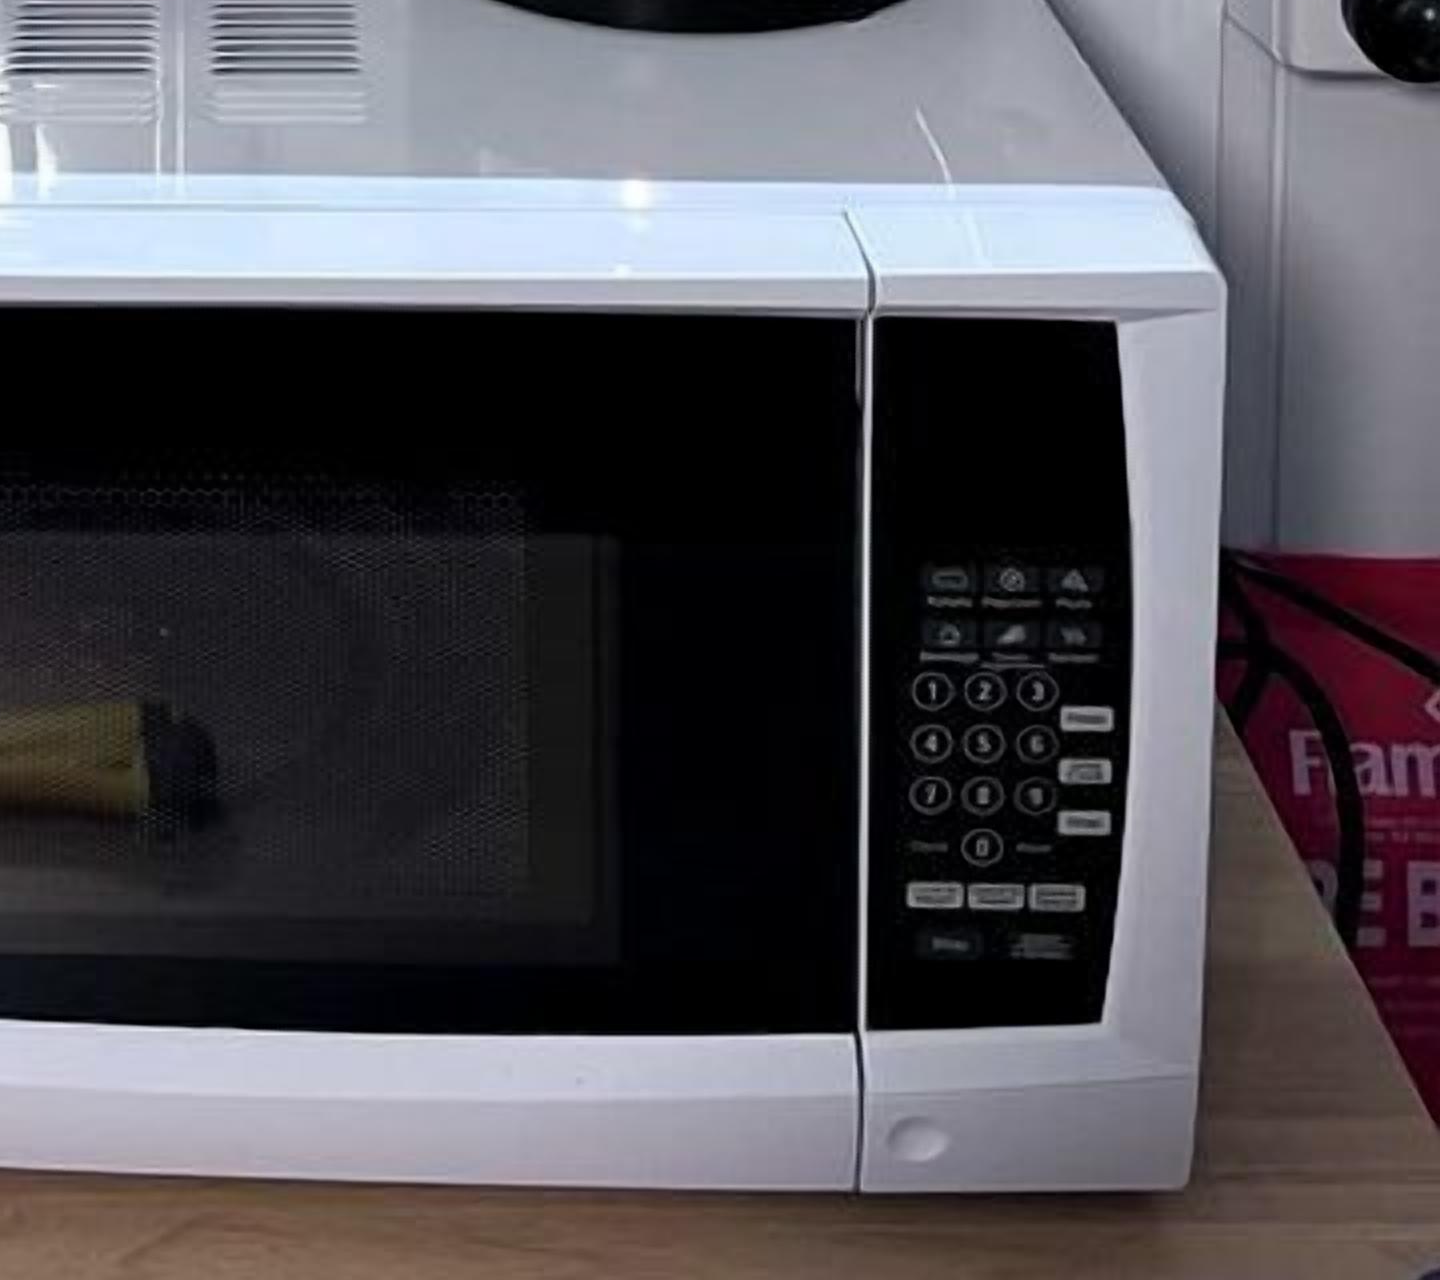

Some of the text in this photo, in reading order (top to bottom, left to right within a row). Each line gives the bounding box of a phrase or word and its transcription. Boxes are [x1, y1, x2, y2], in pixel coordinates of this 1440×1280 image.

[928, 679, 1045, 702] 1 2 3
[924, 732, 1045, 754] 4 5 6
[924, 783, 937, 805] 7
[975, 837, 990, 857] 0
